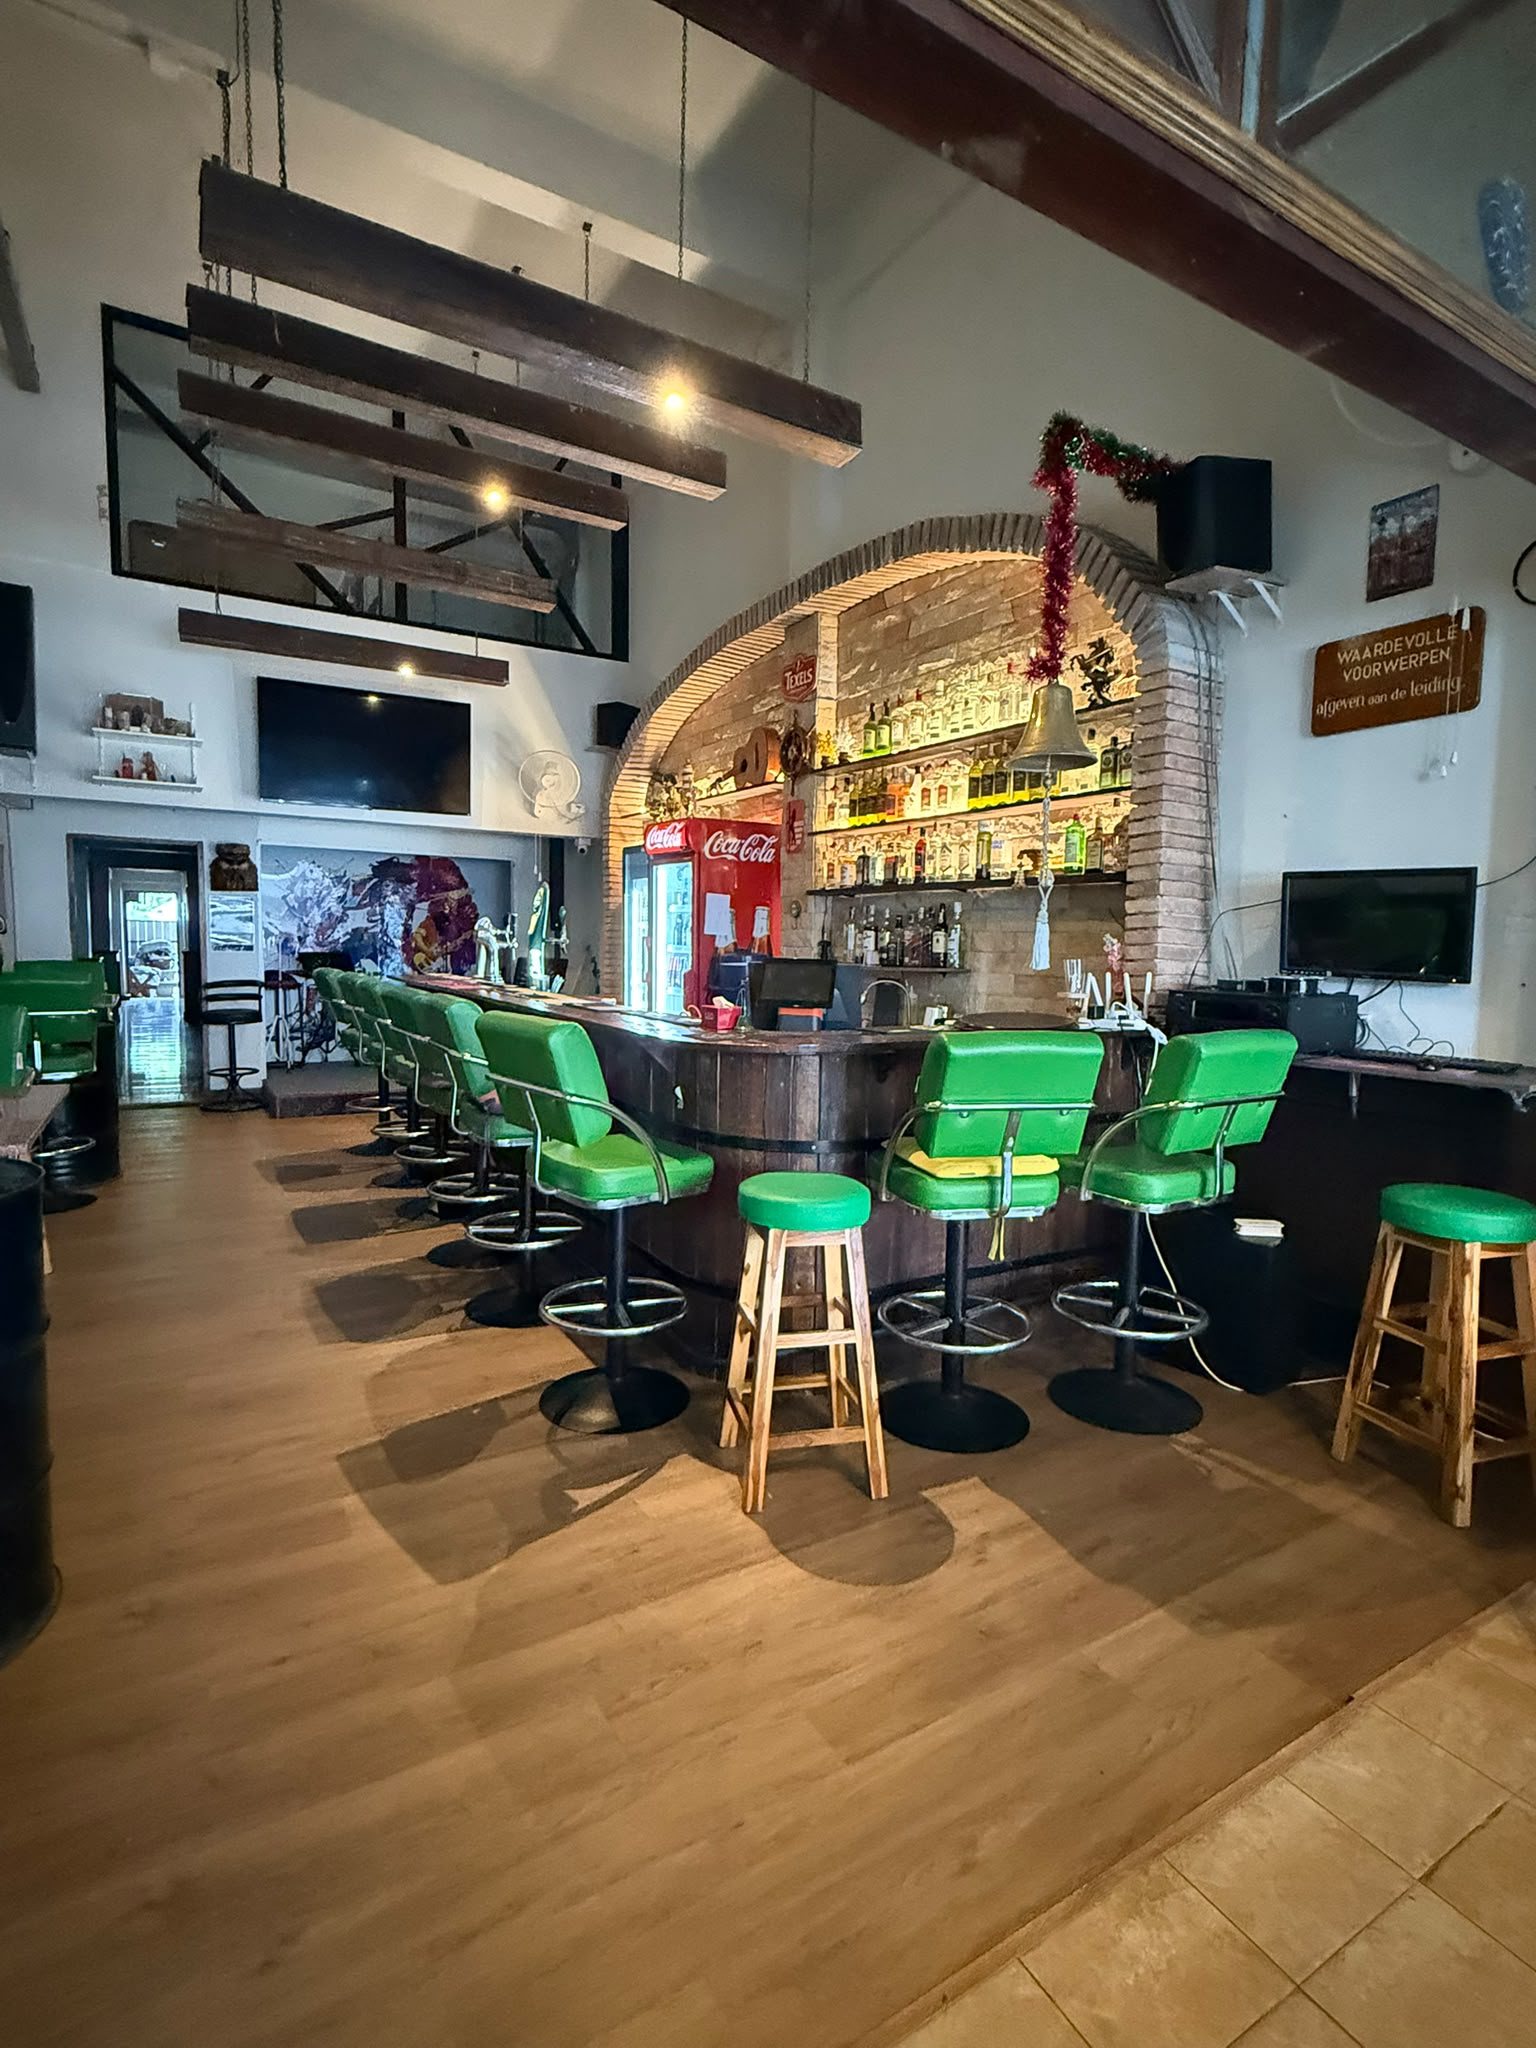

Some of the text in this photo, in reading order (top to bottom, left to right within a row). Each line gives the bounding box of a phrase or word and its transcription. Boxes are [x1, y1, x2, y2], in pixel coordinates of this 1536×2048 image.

[1337, 623, 1459, 665] WAARDEVOLLE
[1343, 646, 1451, 682] VOORWERPEN
[1316, 695, 1366, 718] afgeven
[1368, 693, 1388, 705] aan
[1390, 687, 1407, 701] de
